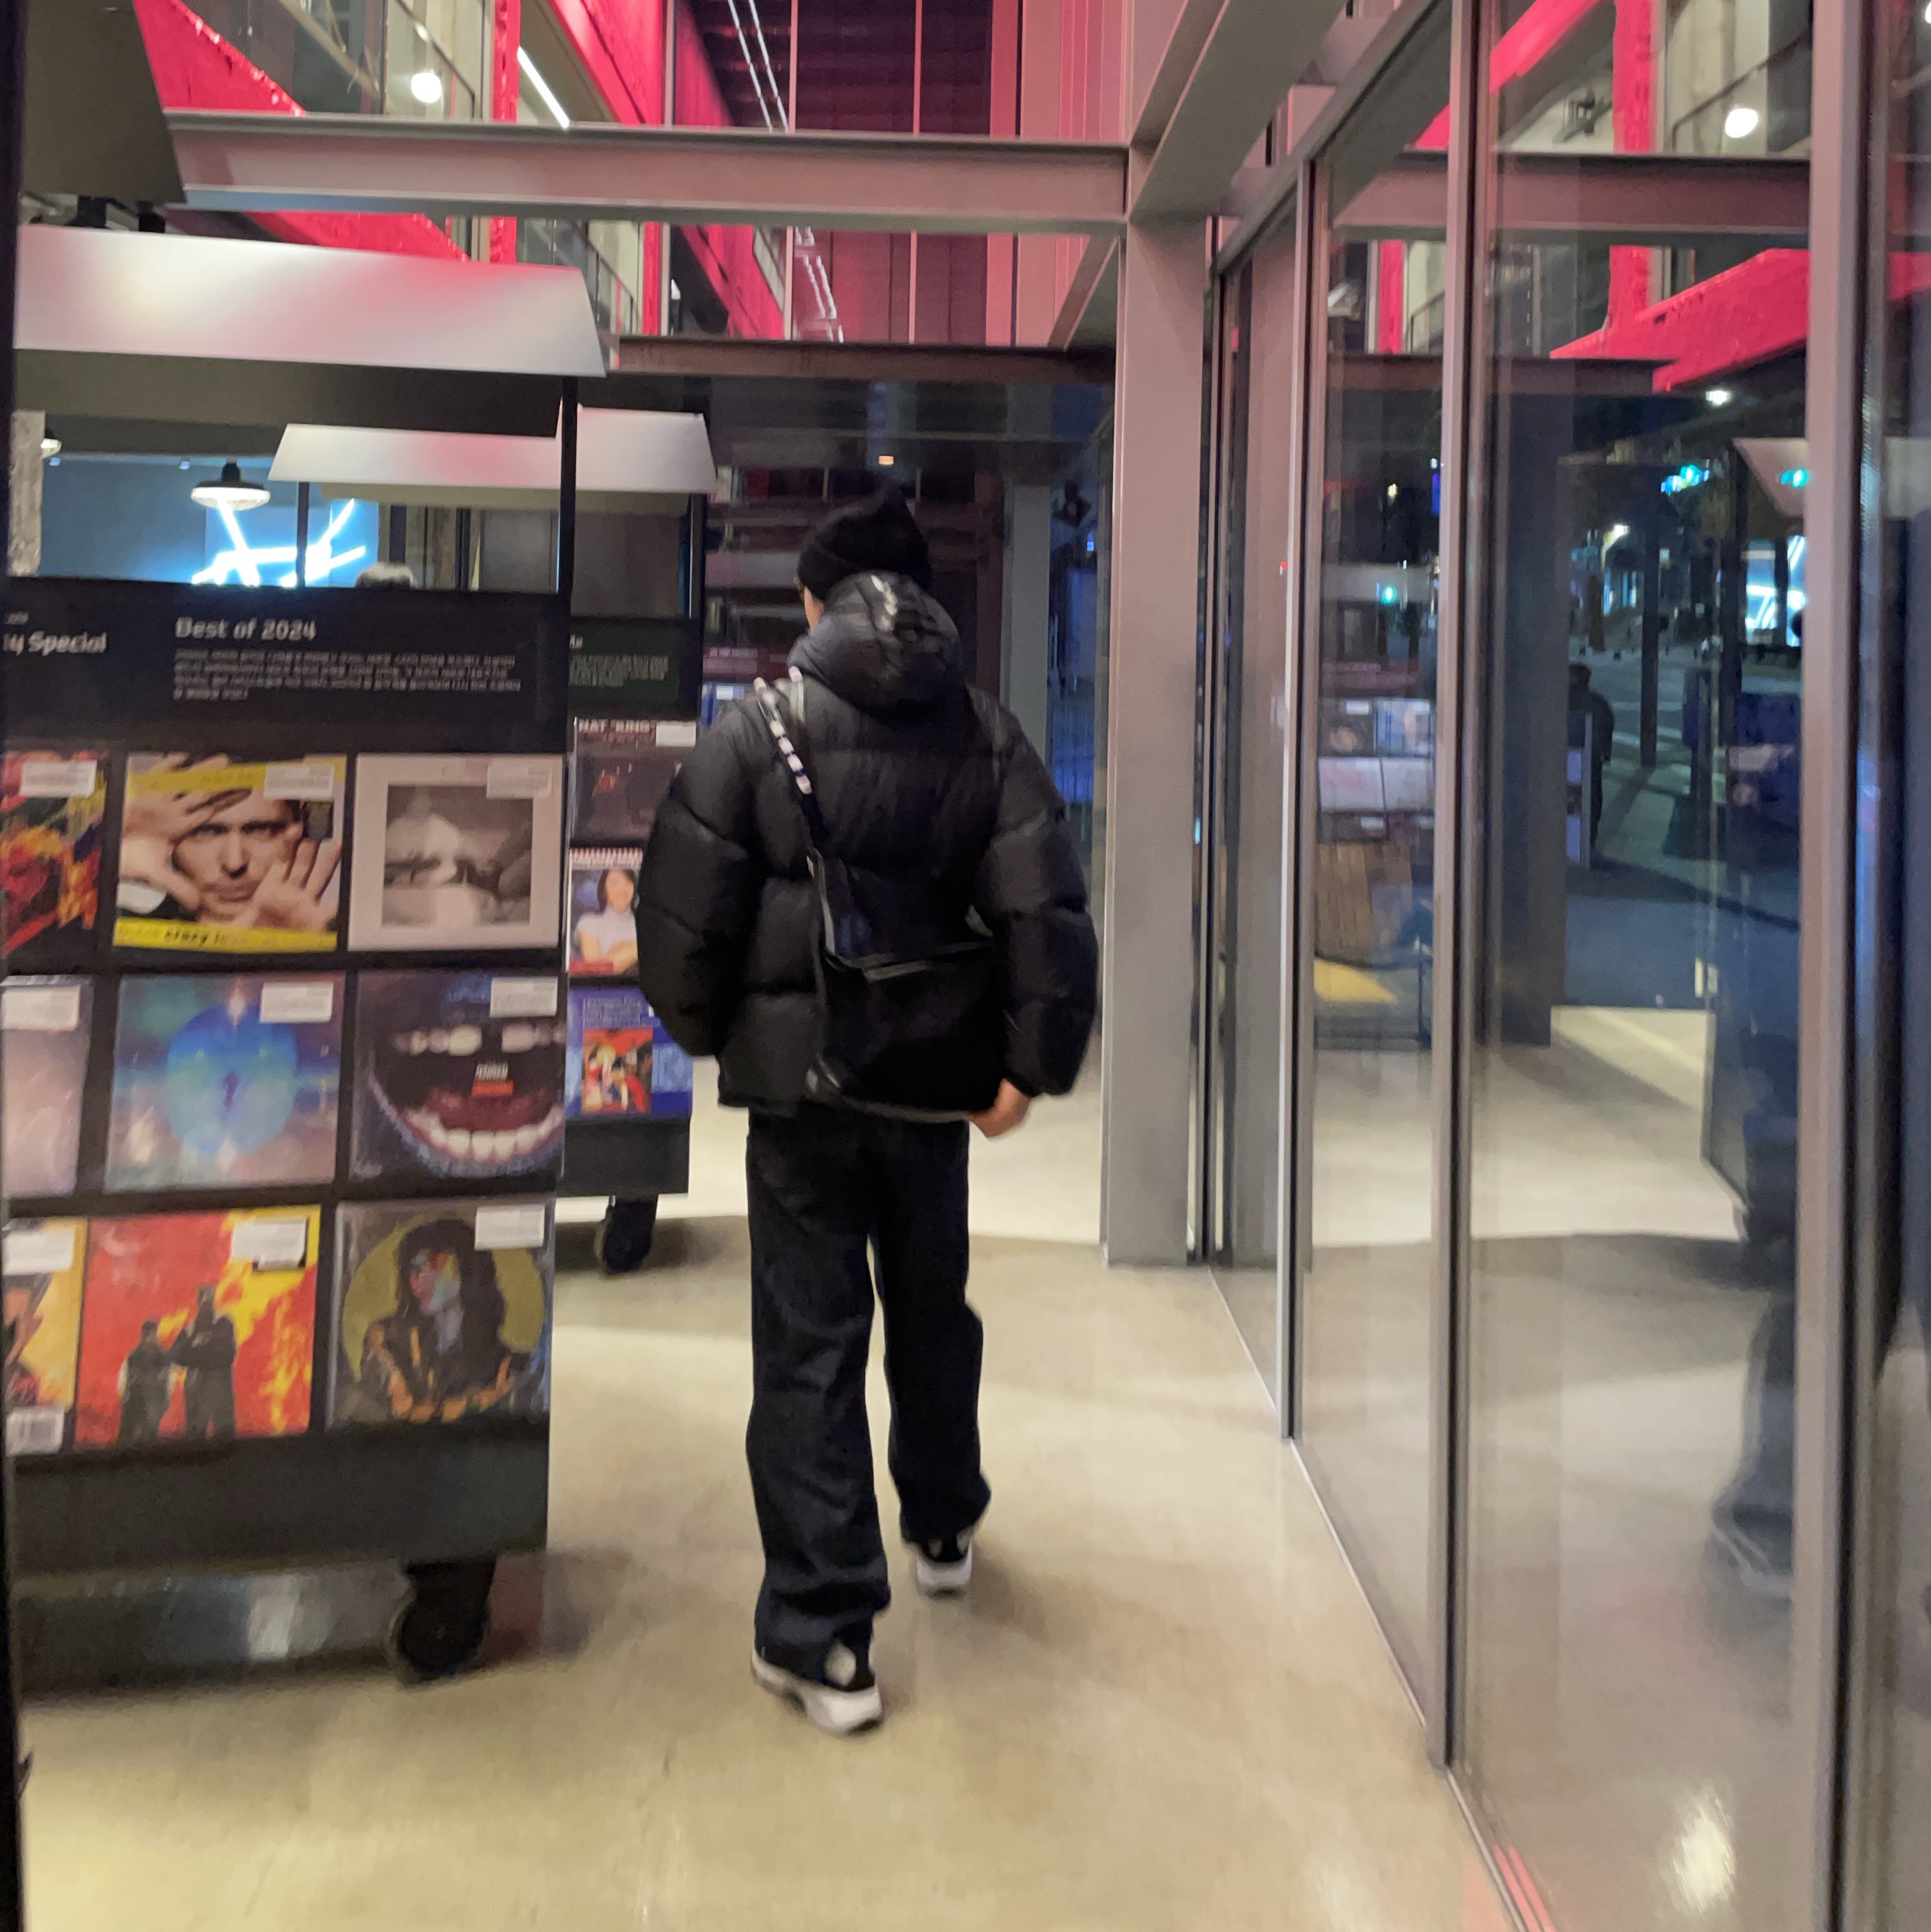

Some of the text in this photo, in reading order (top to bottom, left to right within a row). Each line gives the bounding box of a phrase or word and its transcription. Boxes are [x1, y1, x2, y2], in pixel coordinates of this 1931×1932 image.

[175, 616, 317, 641] Best of 2024
[28, 630, 107, 657] Special
